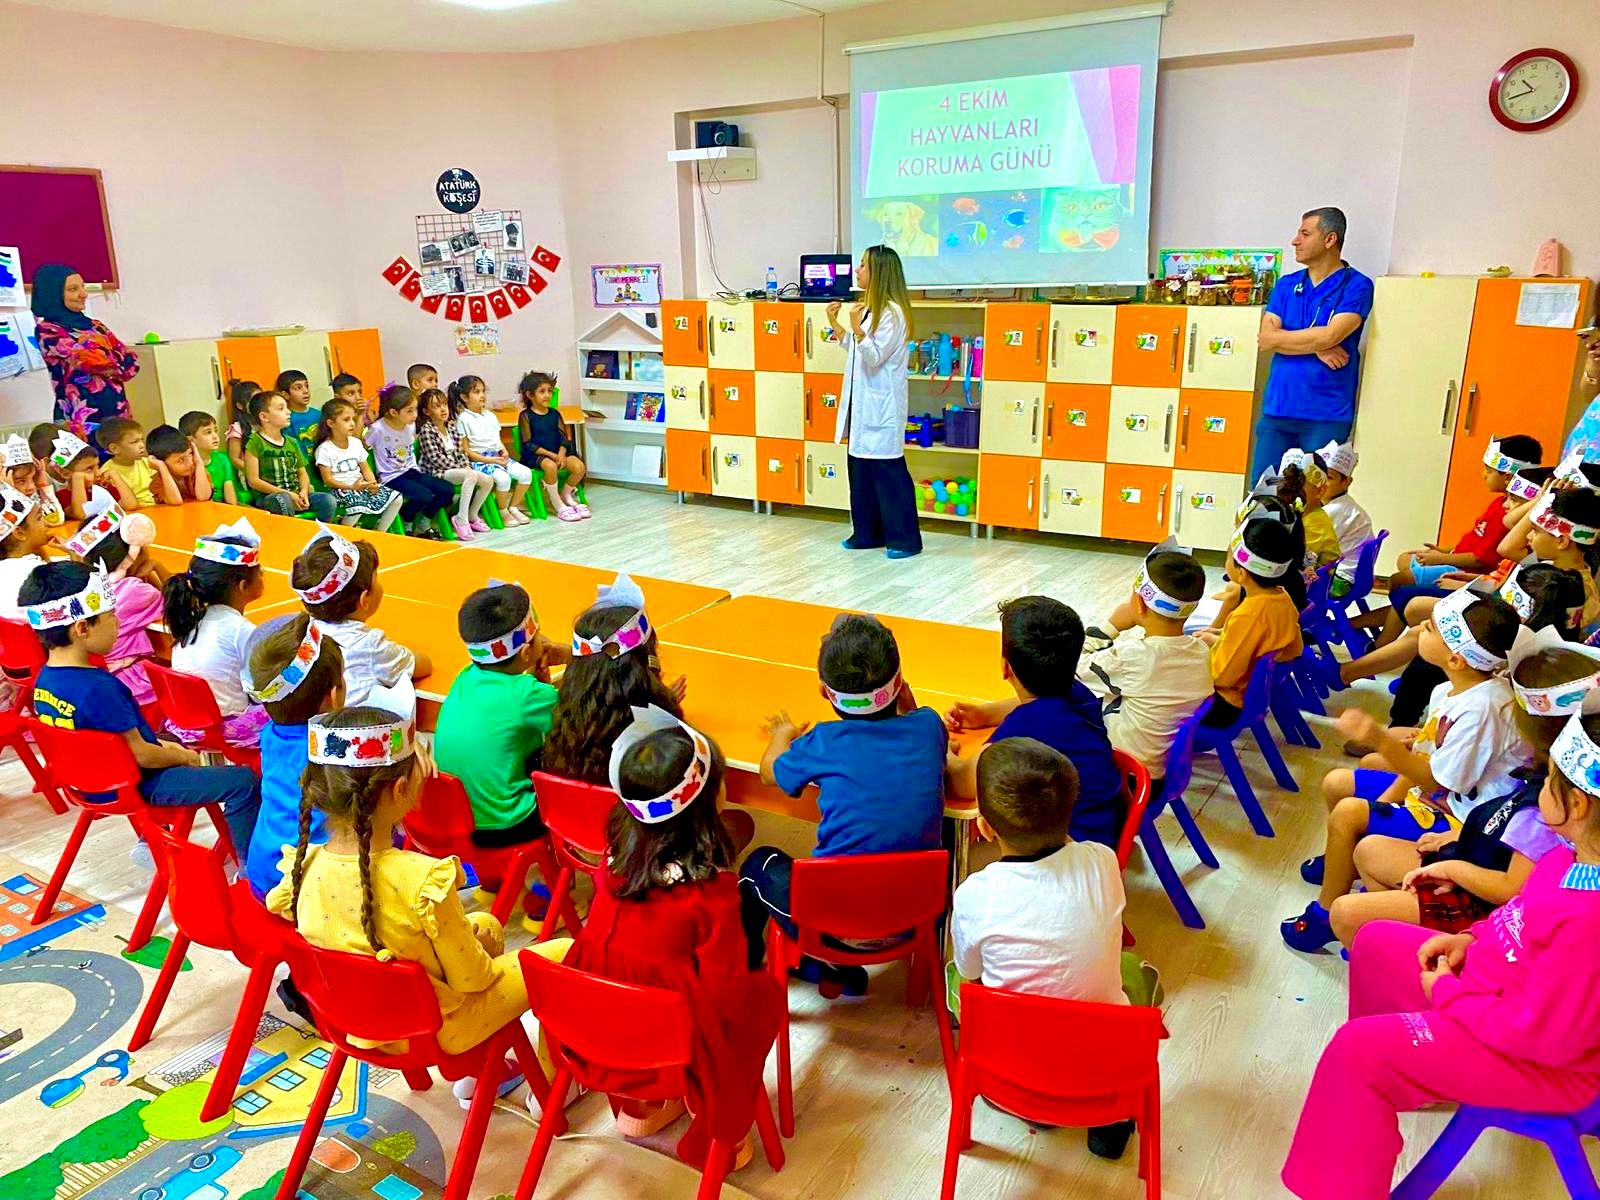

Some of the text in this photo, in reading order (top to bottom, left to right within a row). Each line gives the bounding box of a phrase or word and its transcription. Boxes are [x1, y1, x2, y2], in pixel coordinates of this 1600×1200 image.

[939, 86, 1009, 112] 4 EKİM
[910, 118, 1039, 146] HAYVANLARI
[897, 144, 1051, 177] KORUMA GÜNÜ
[439, 180, 477, 190] ATATÜRK
